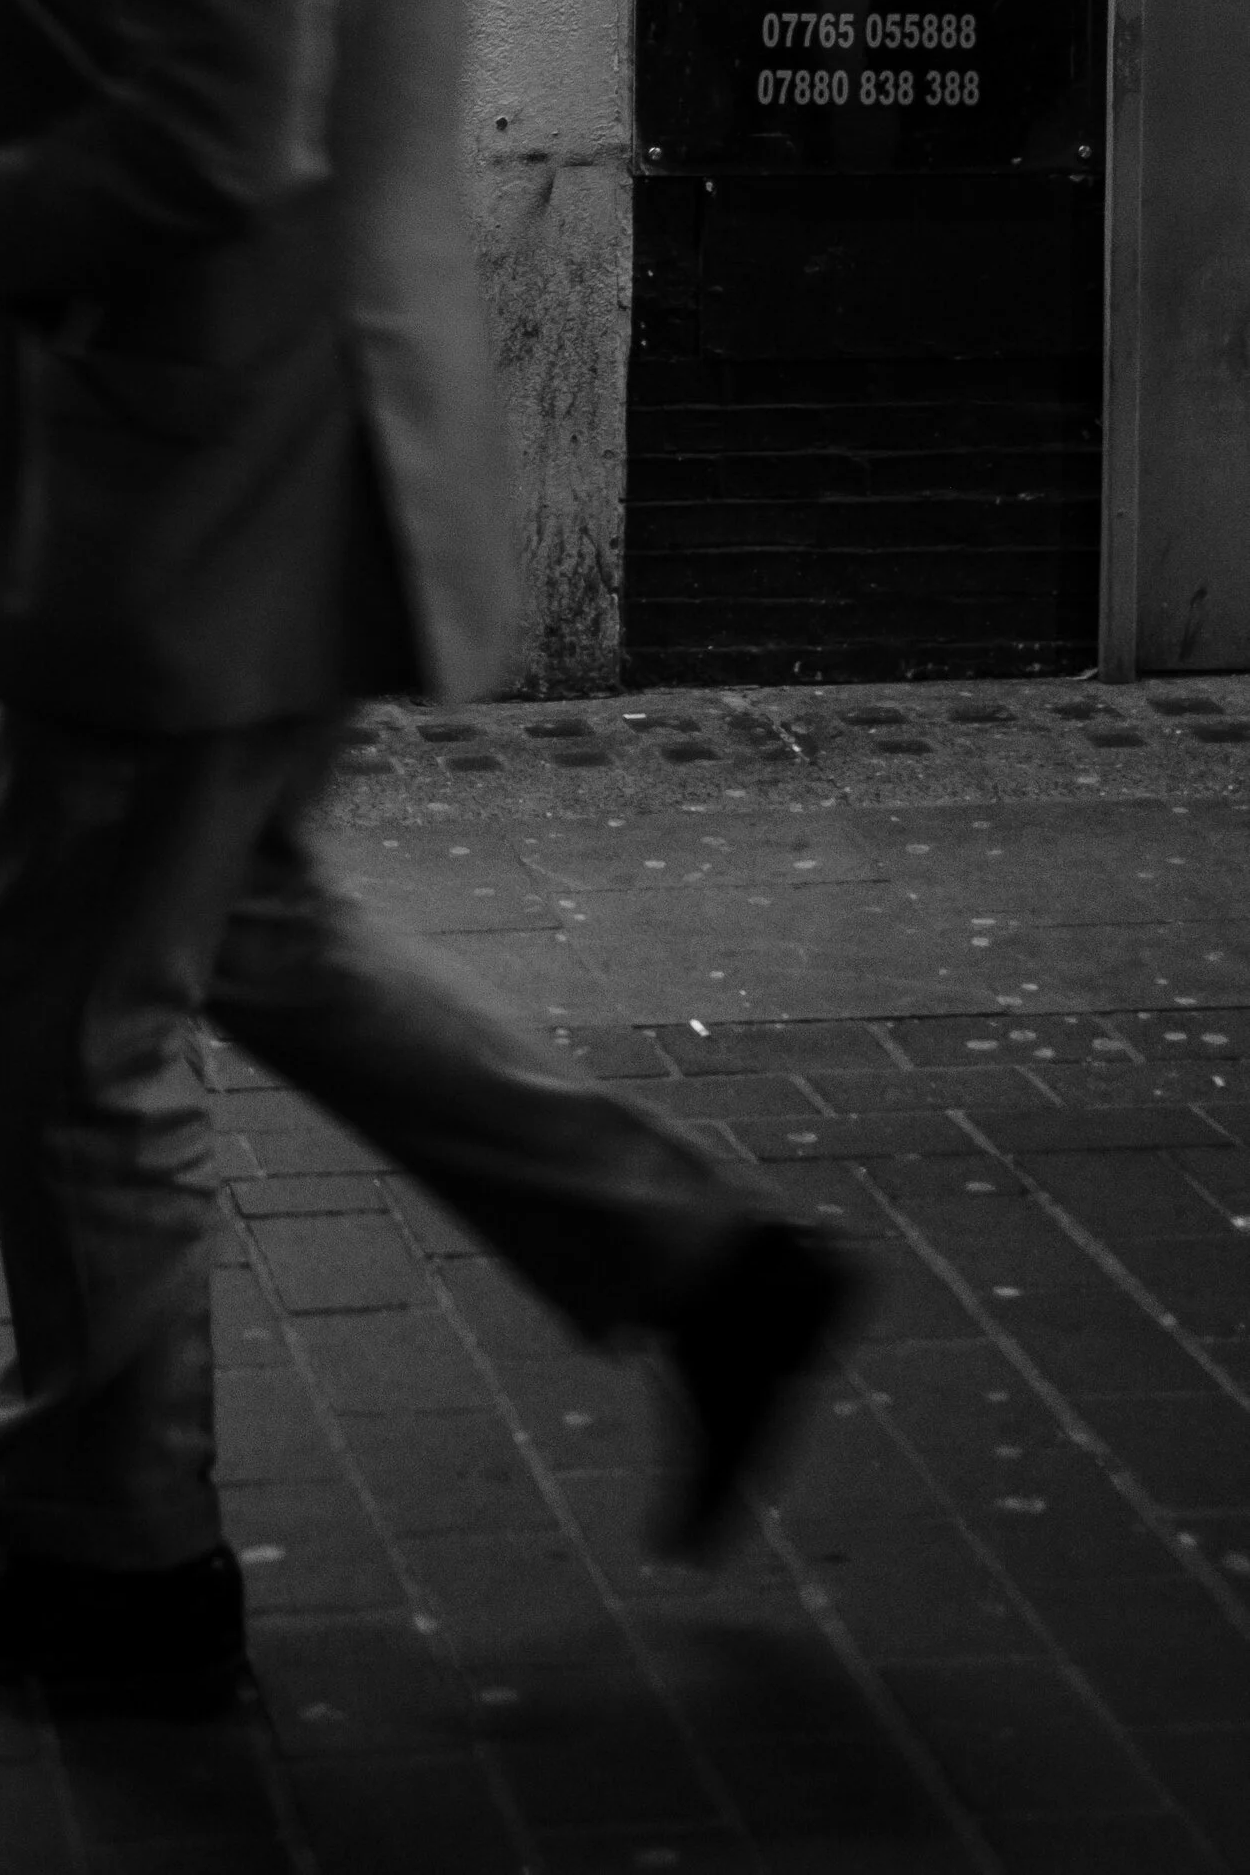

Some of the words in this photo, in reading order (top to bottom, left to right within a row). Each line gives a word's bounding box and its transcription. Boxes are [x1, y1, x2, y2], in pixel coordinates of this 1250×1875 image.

[762, 12, 855, 50] 07765
[865, 12, 977, 50] 055888
[757, 69, 849, 106] 07880
[859, 69, 915, 106] 838
[925, 69, 980, 106] 388
